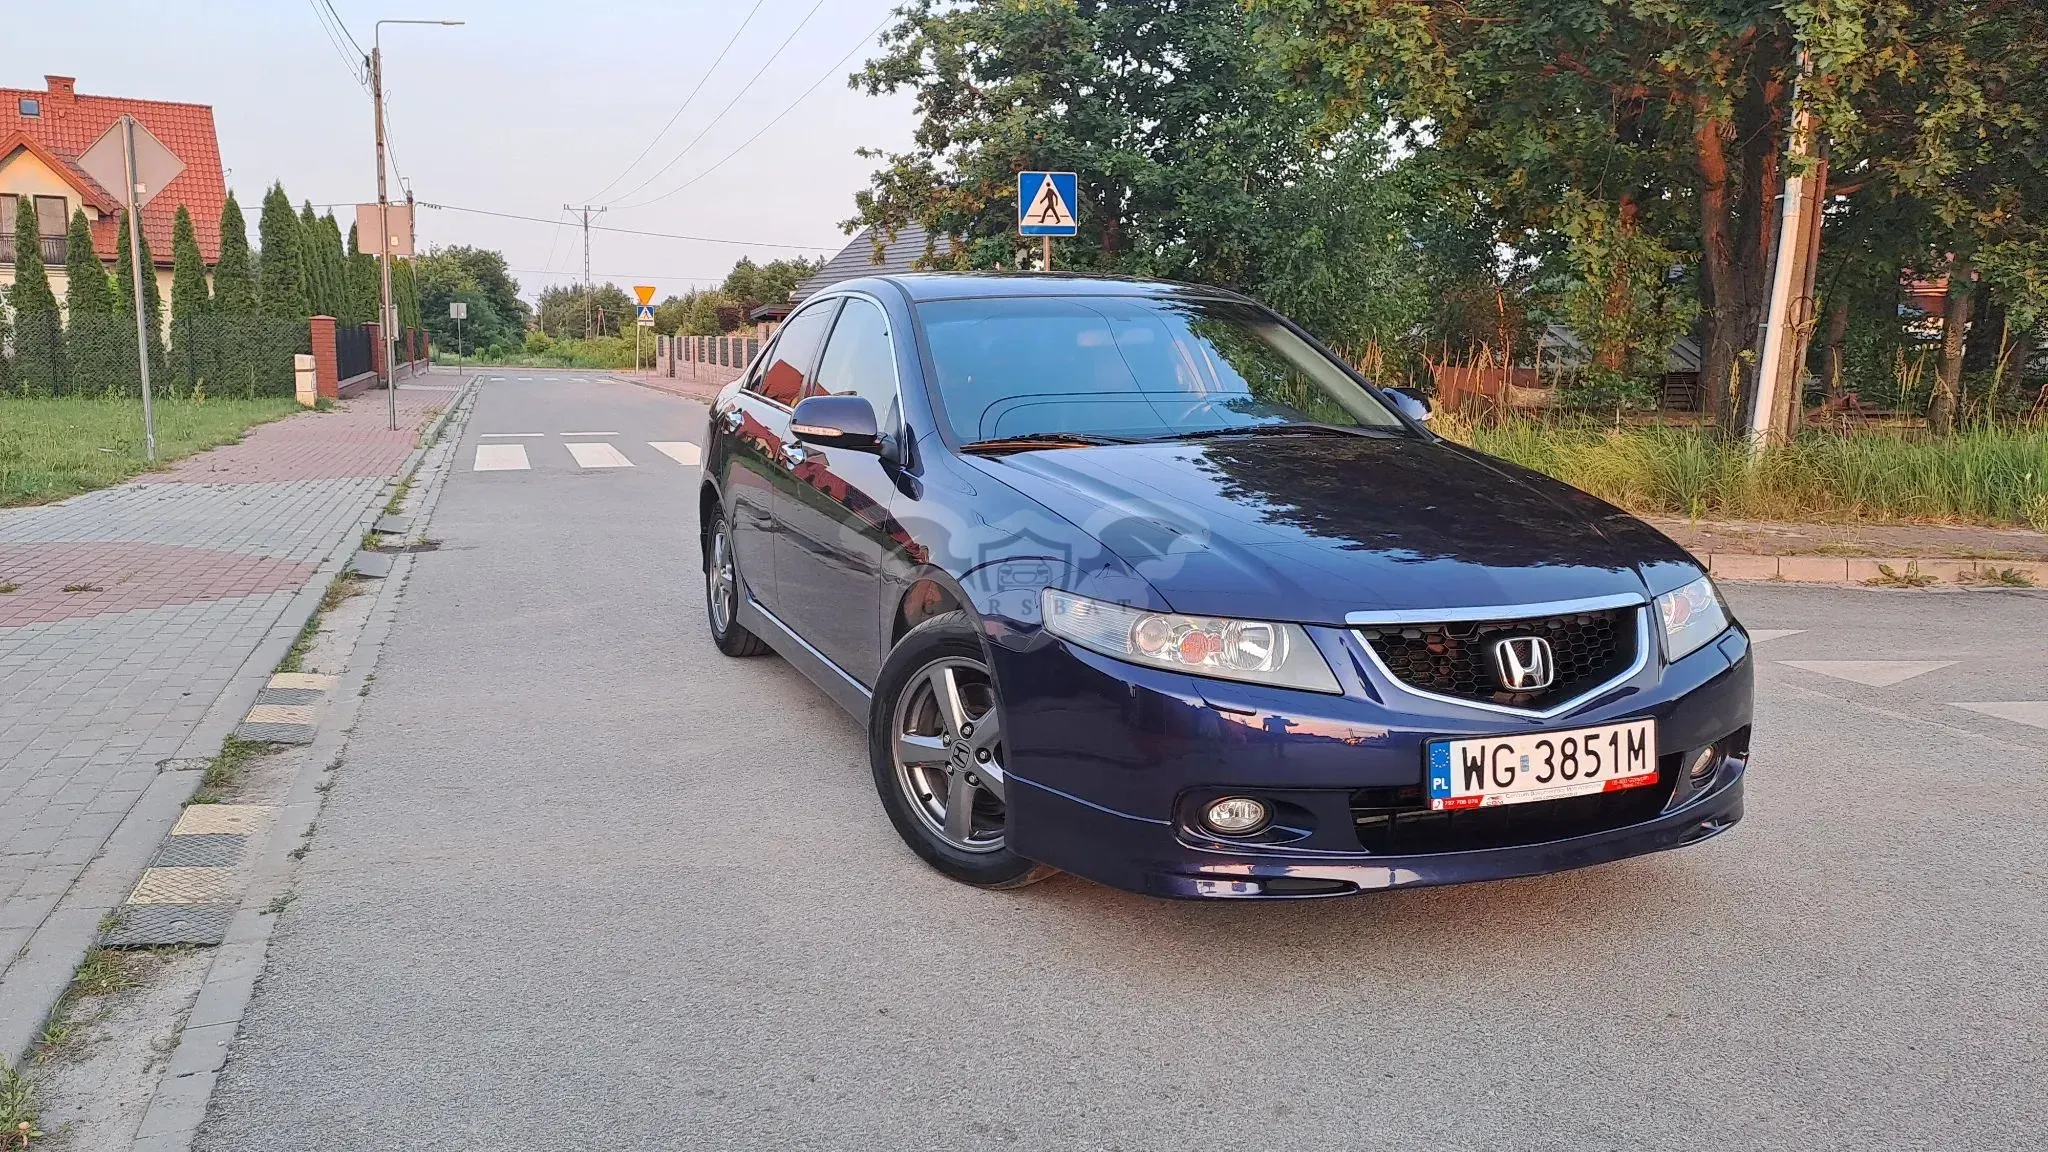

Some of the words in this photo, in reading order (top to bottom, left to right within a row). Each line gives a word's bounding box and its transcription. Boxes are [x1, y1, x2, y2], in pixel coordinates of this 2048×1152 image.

[1461, 744, 1515, 791] WG
[1535, 727, 1646, 783] 3851M
[1433, 777, 1449, 790] PL
